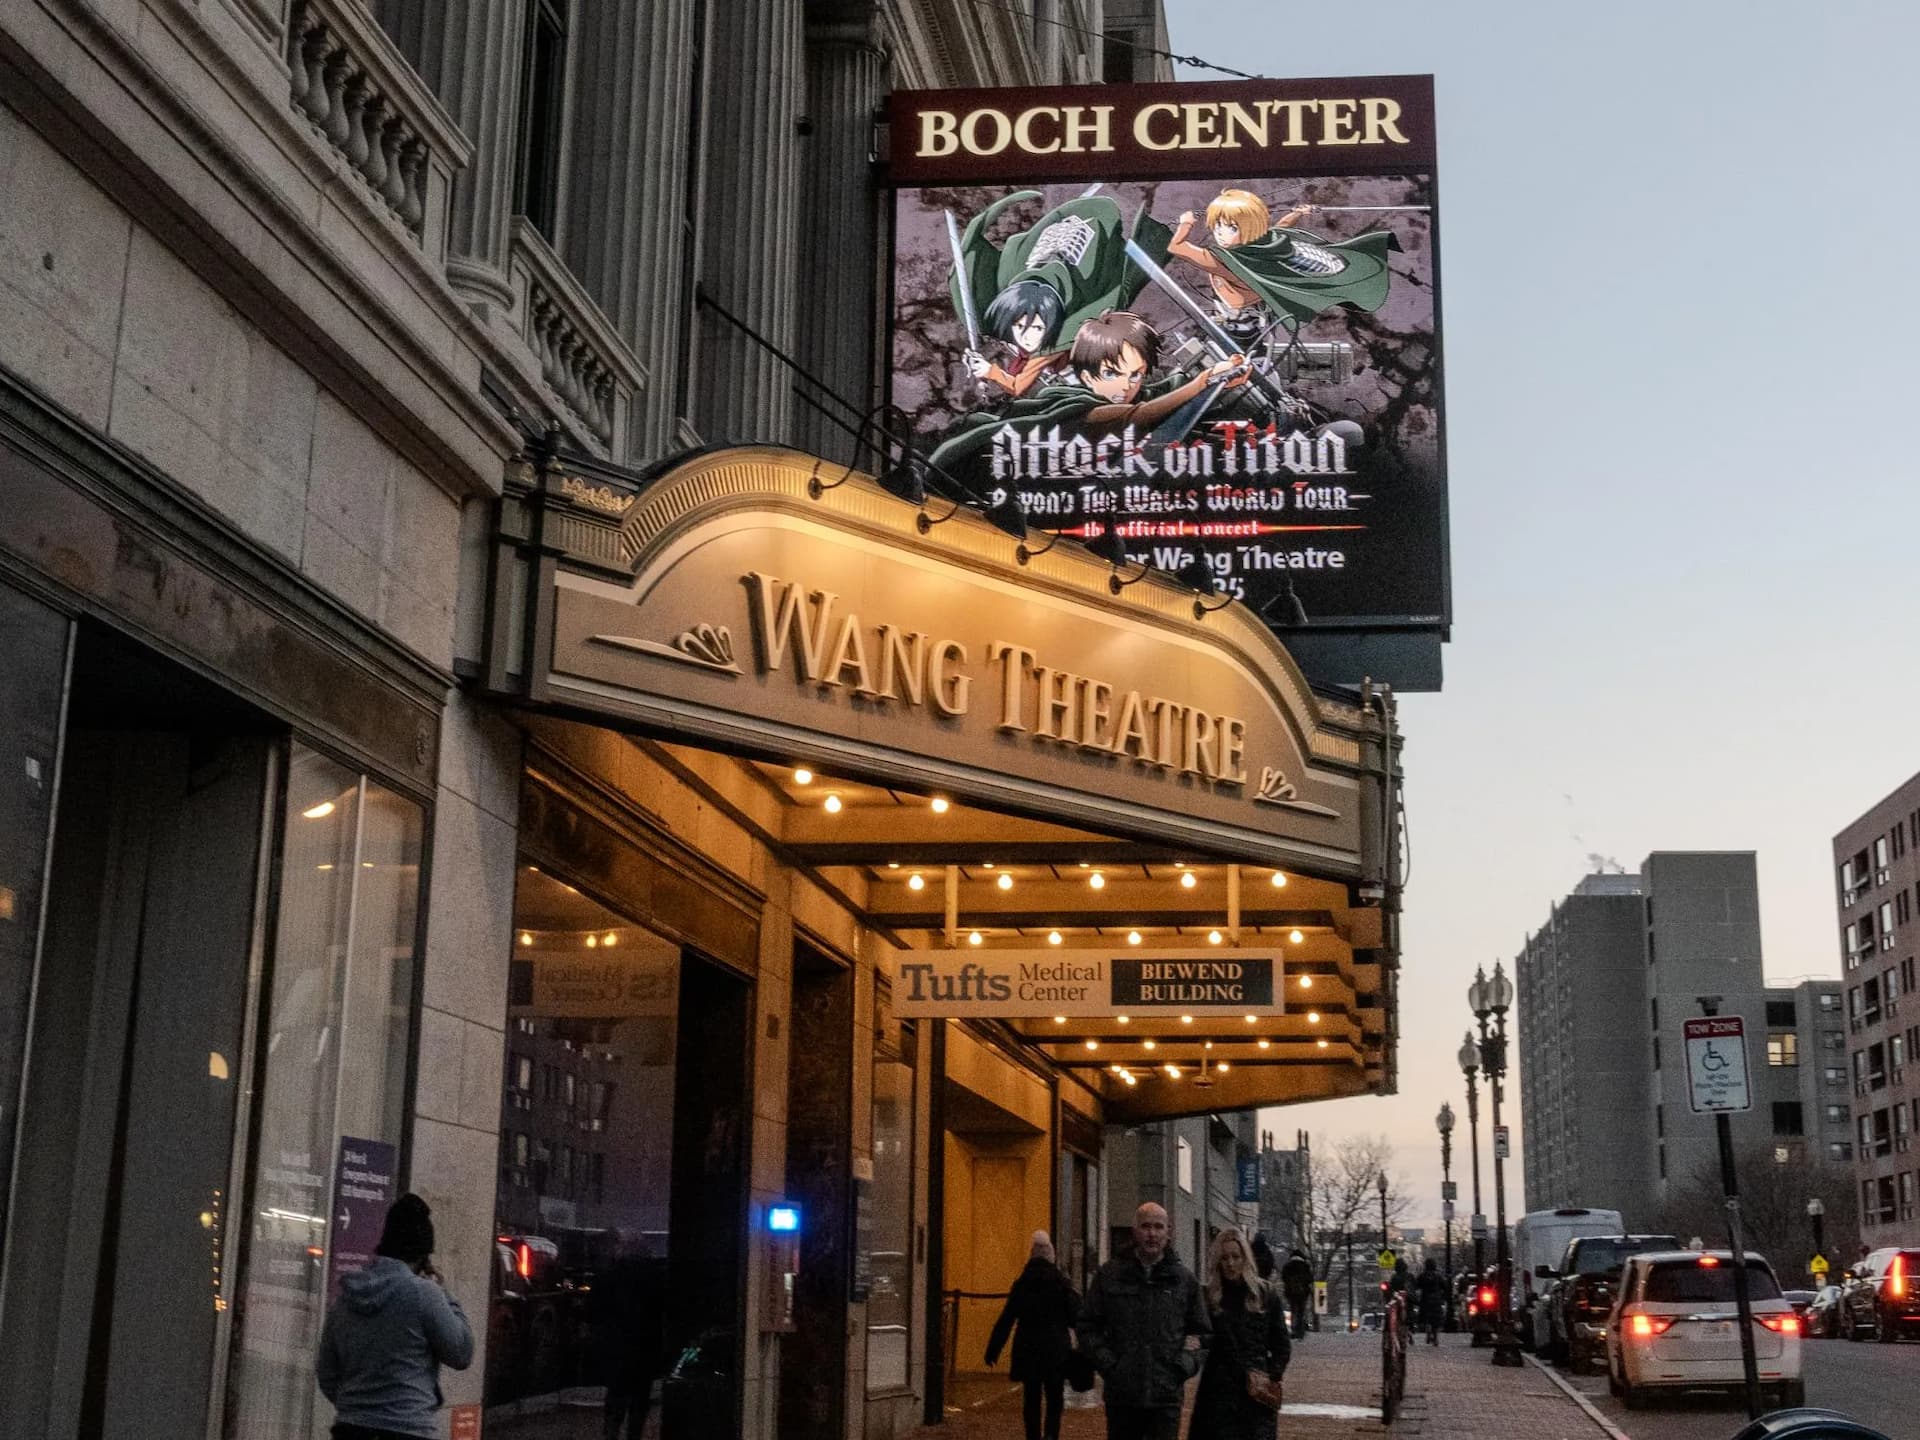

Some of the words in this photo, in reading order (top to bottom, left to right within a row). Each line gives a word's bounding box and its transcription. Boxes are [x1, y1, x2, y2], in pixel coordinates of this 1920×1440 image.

[915, 105, 1114, 157] BOCH
[1133, 97, 1410, 150] CENTER
[987, 422, 1161, 479] Attack
[1163, 440, 1214, 478] on
[1212, 418, 1349, 476] Titan
[1084, 521, 1104, 538] th
[1116, 520, 1184, 537] official
[1236, 545, 1345, 569] Theatre
[1018, 961, 1103, 982] Medical
[1141, 963, 1243, 980] BIEWEND
[900, 963, 1012, 1001] Tufts
[1018, 983, 1090, 1001] Center
[1140, 985, 1244, 1001] BUILDING
[1687, 1024, 1709, 1034] TOW
[1710, 1021, 1740, 1033] ZONE
